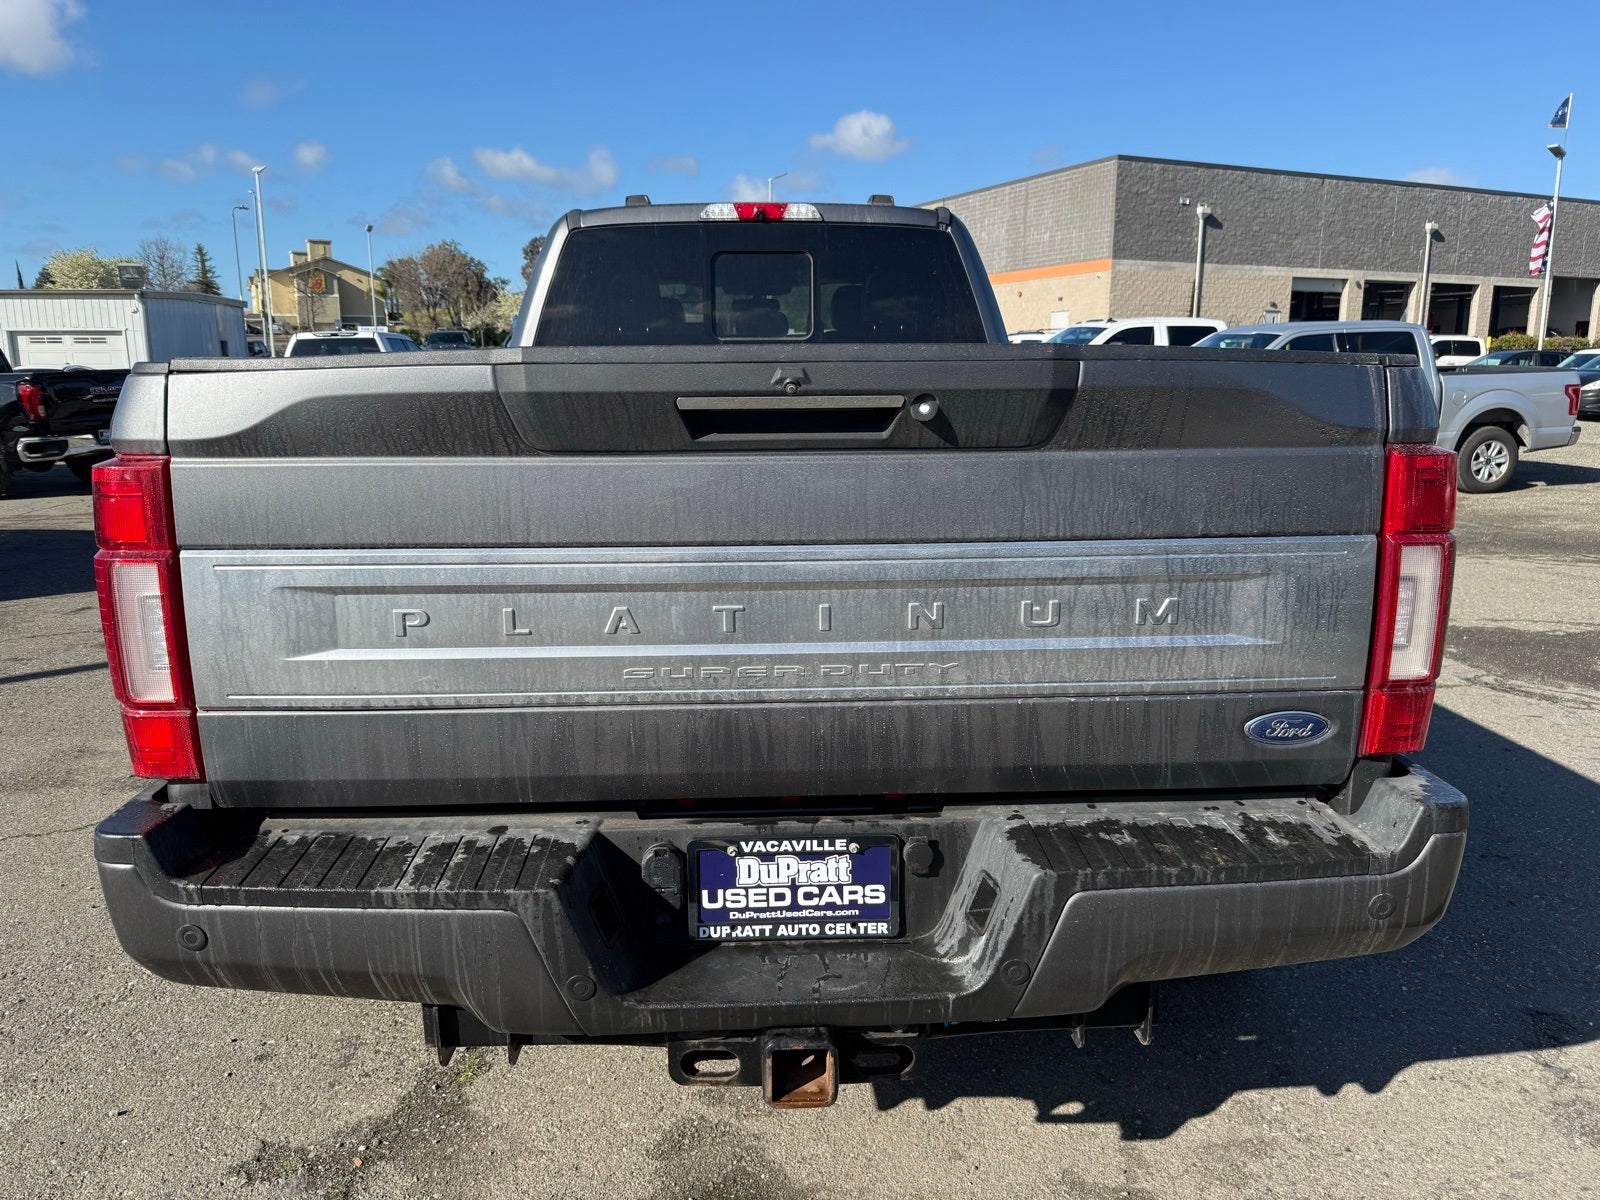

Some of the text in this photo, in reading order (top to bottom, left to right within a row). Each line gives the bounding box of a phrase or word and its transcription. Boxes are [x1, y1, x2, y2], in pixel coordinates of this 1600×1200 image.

[392, 597, 1180, 637] PLATINUM
[623, 662, 959, 679] SUPER DUTY
[1265, 719, 1315, 738] Ford
[740, 839, 847, 853] VACAVILLE
[736, 855, 852, 887] DuPratt
[702, 884, 886, 909] USED CARS
[729, 908, 859, 920] DuPrattUsedCars.com
[699, 922, 889, 938] DUPRATT AUTO CENTER
